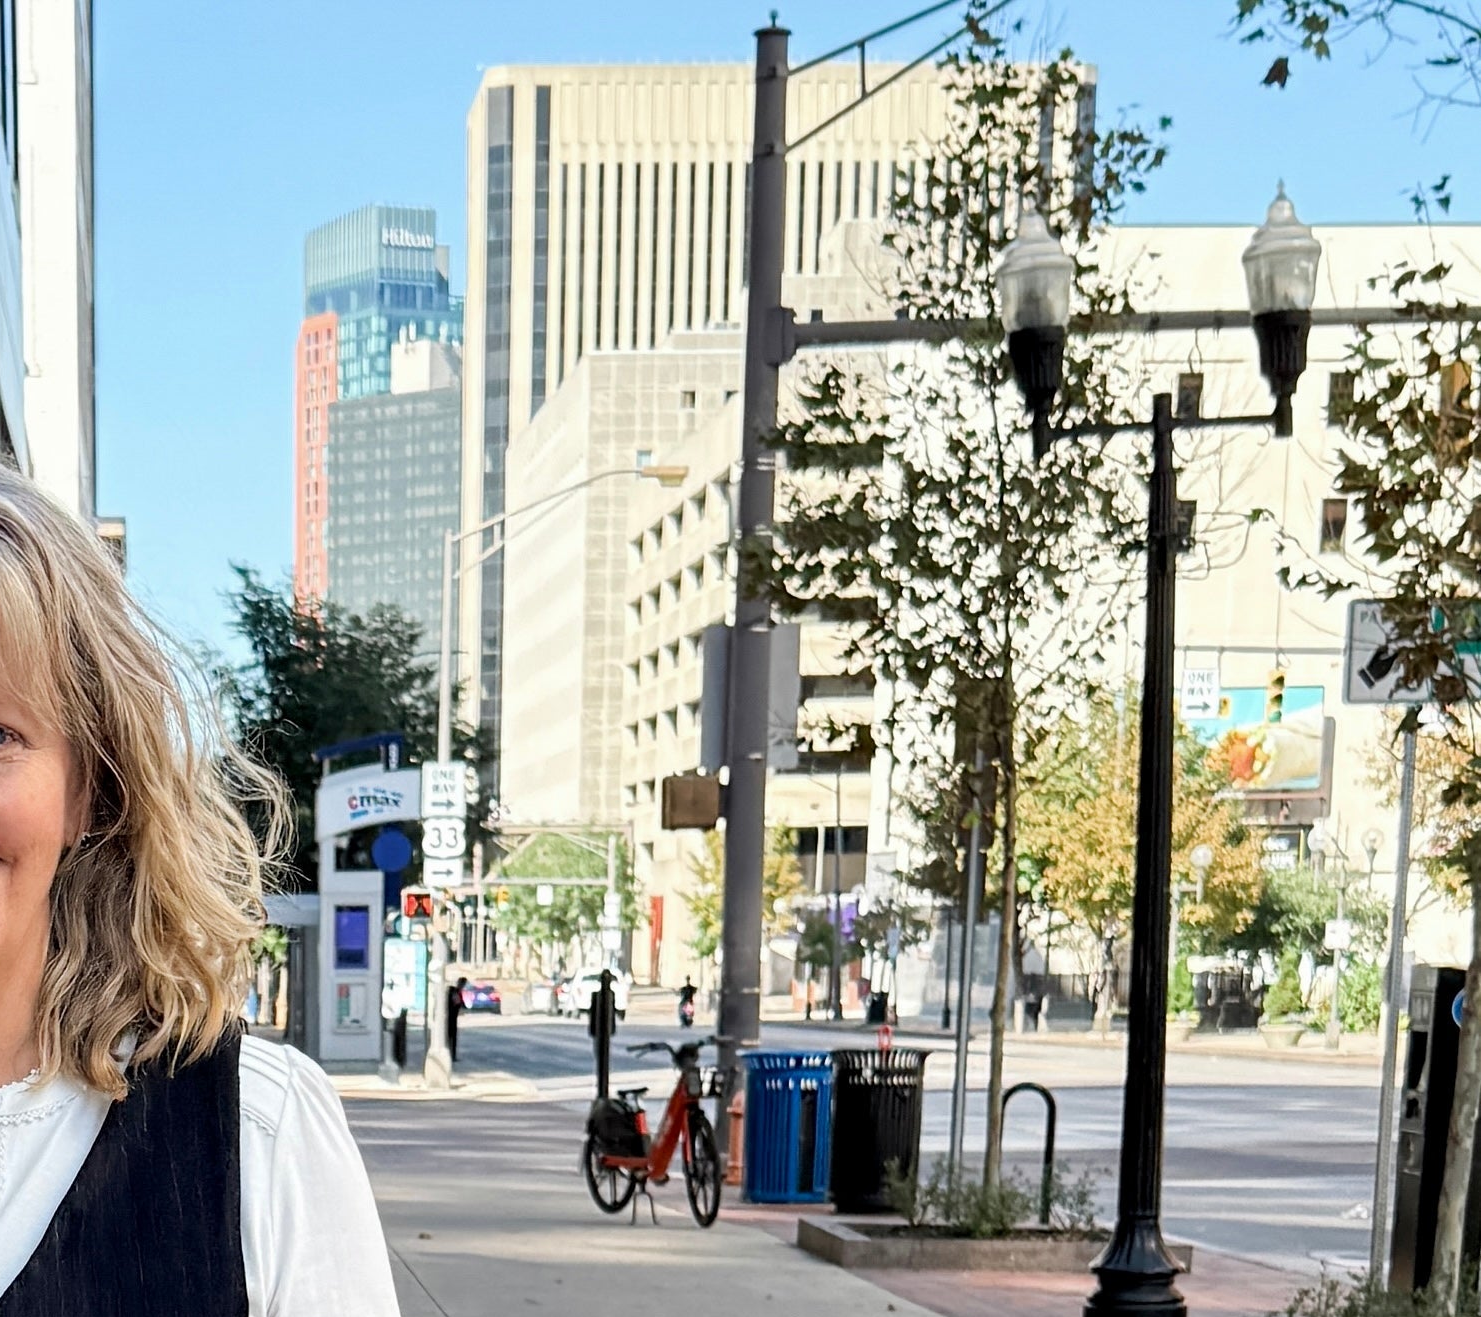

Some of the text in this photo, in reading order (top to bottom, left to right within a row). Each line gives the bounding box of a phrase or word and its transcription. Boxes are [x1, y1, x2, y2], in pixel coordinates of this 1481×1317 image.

[381, 227, 434, 249] Hilton
[1188, 671, 1215, 685] ONE
[1187, 687, 1214, 697] WAY
[431, 769, 456, 781] ONE
[429, 826, 458, 849] 33
